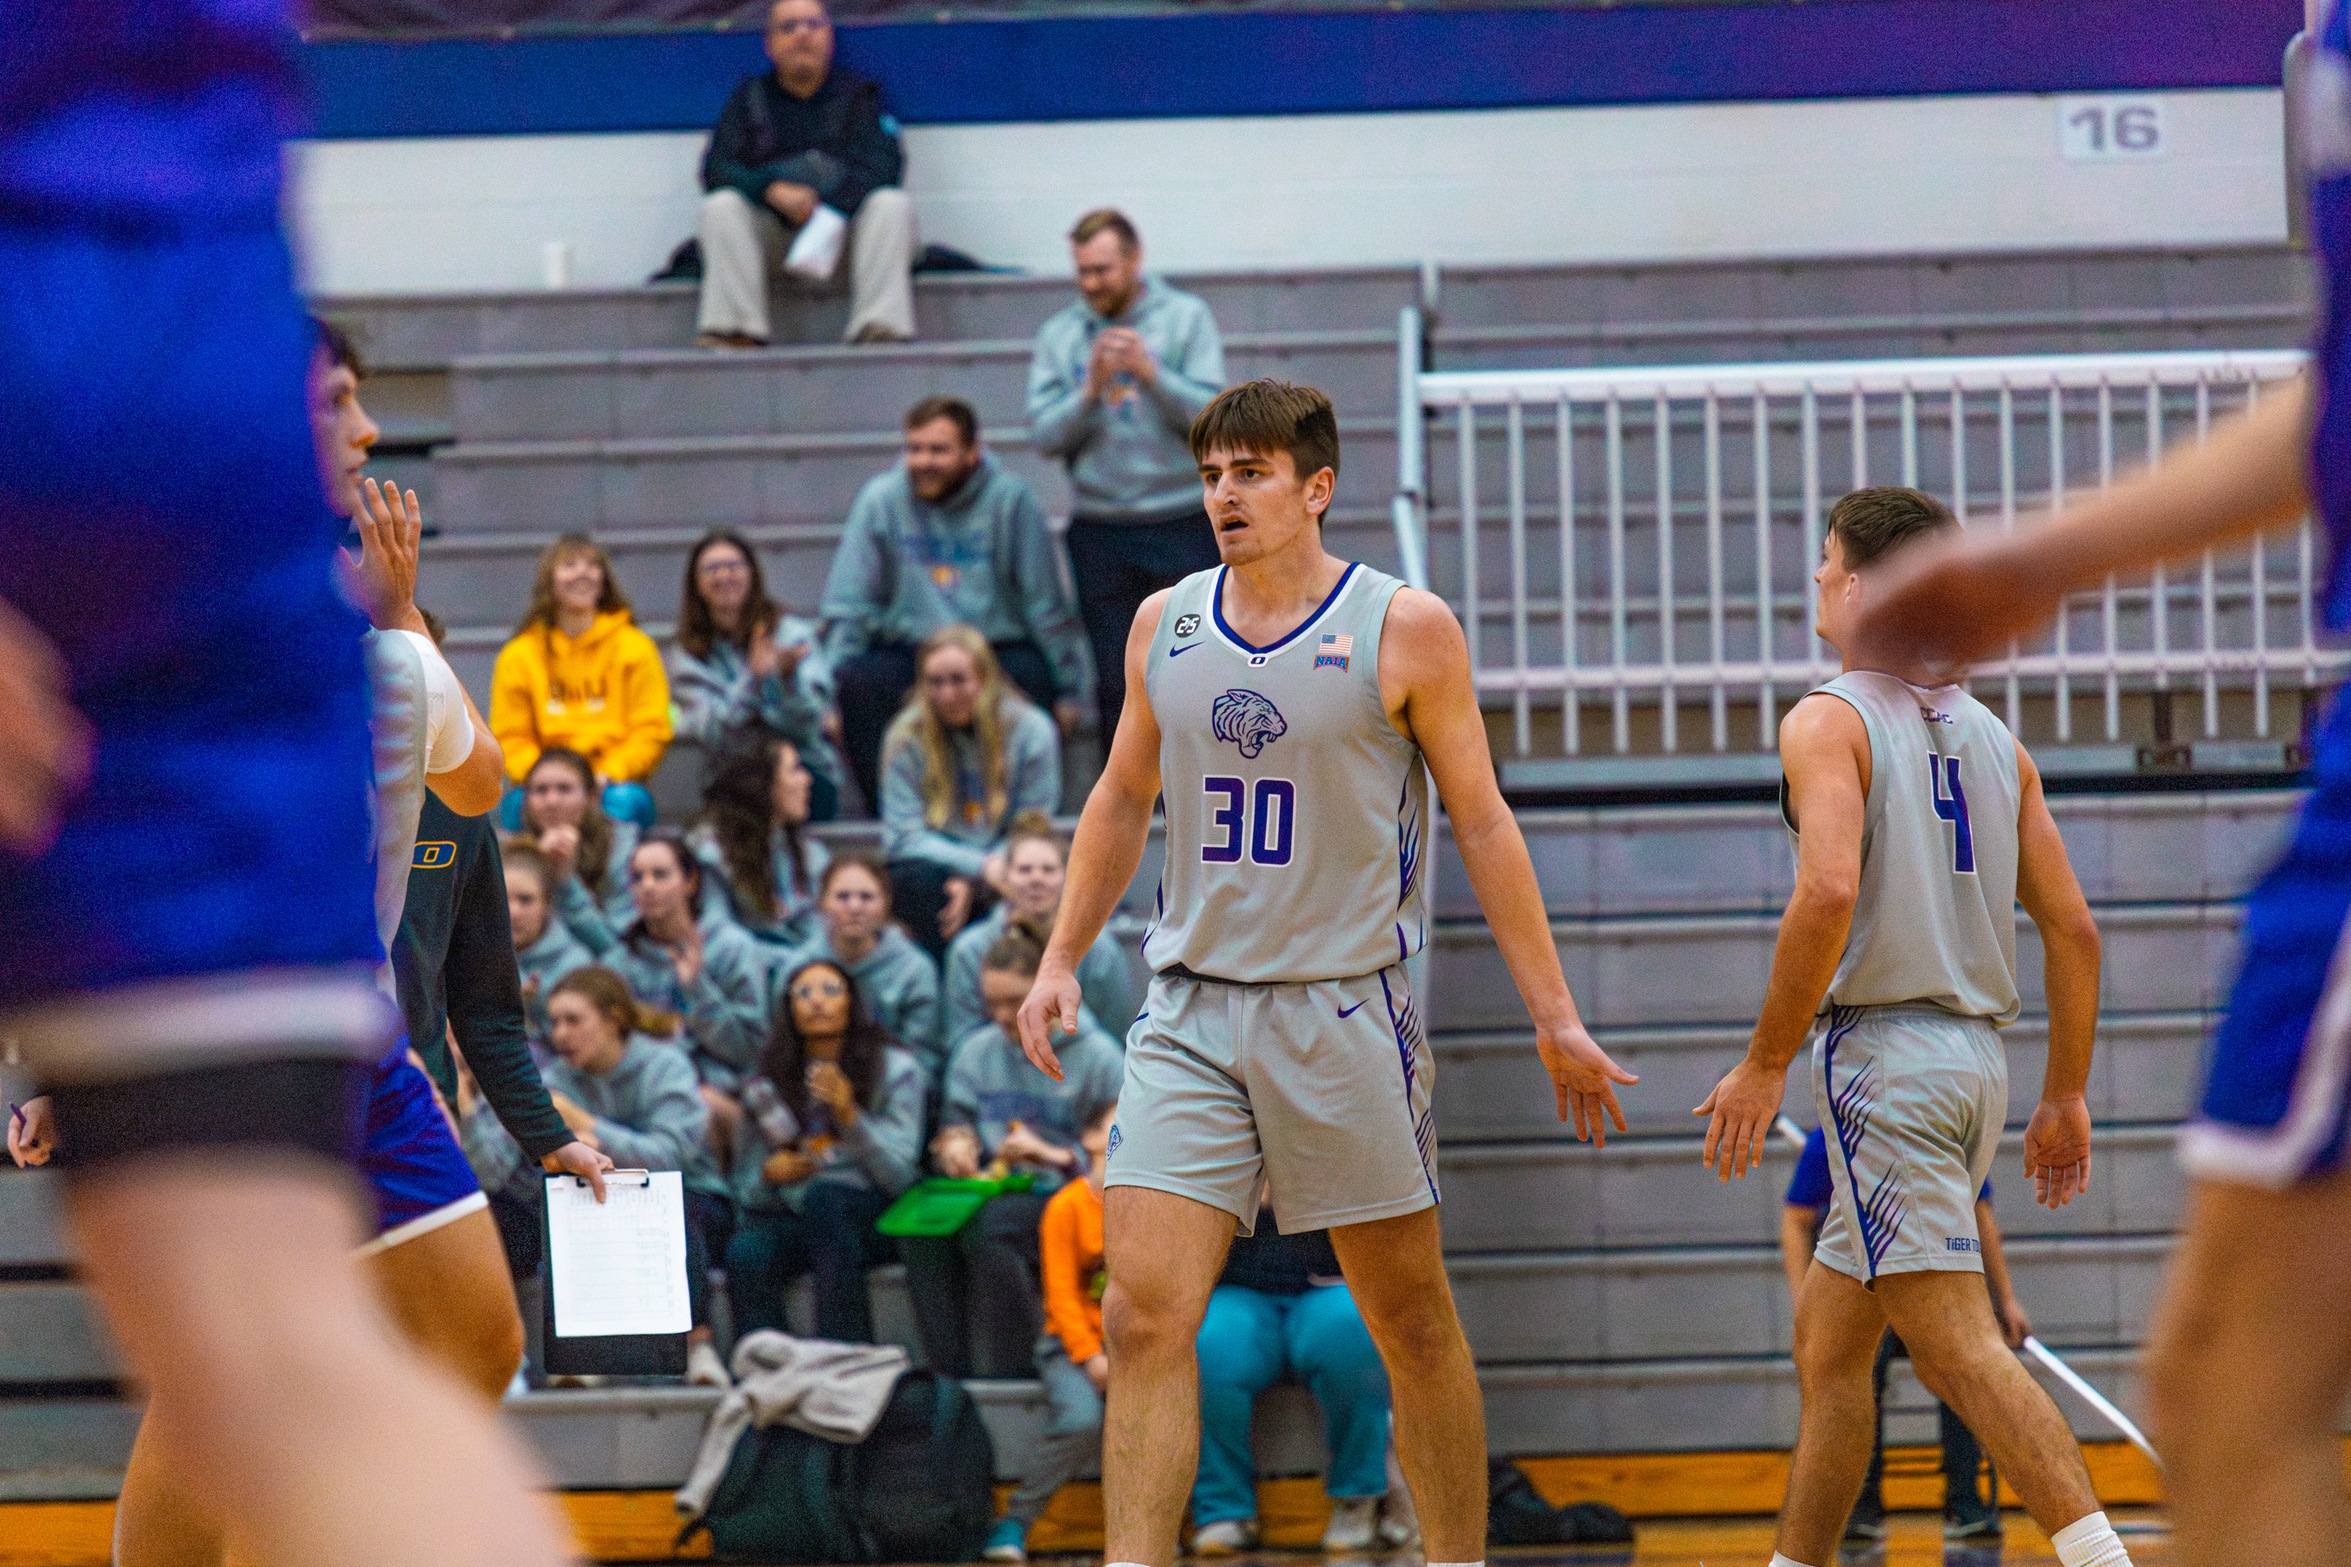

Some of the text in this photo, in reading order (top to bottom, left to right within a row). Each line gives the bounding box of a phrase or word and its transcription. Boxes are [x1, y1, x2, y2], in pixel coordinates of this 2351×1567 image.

[2069, 106, 2160, 150] 16
[1313, 655, 1348, 671] NAIA
[1201, 775, 1296, 867] 30
[1927, 750, 1976, 874] 4
